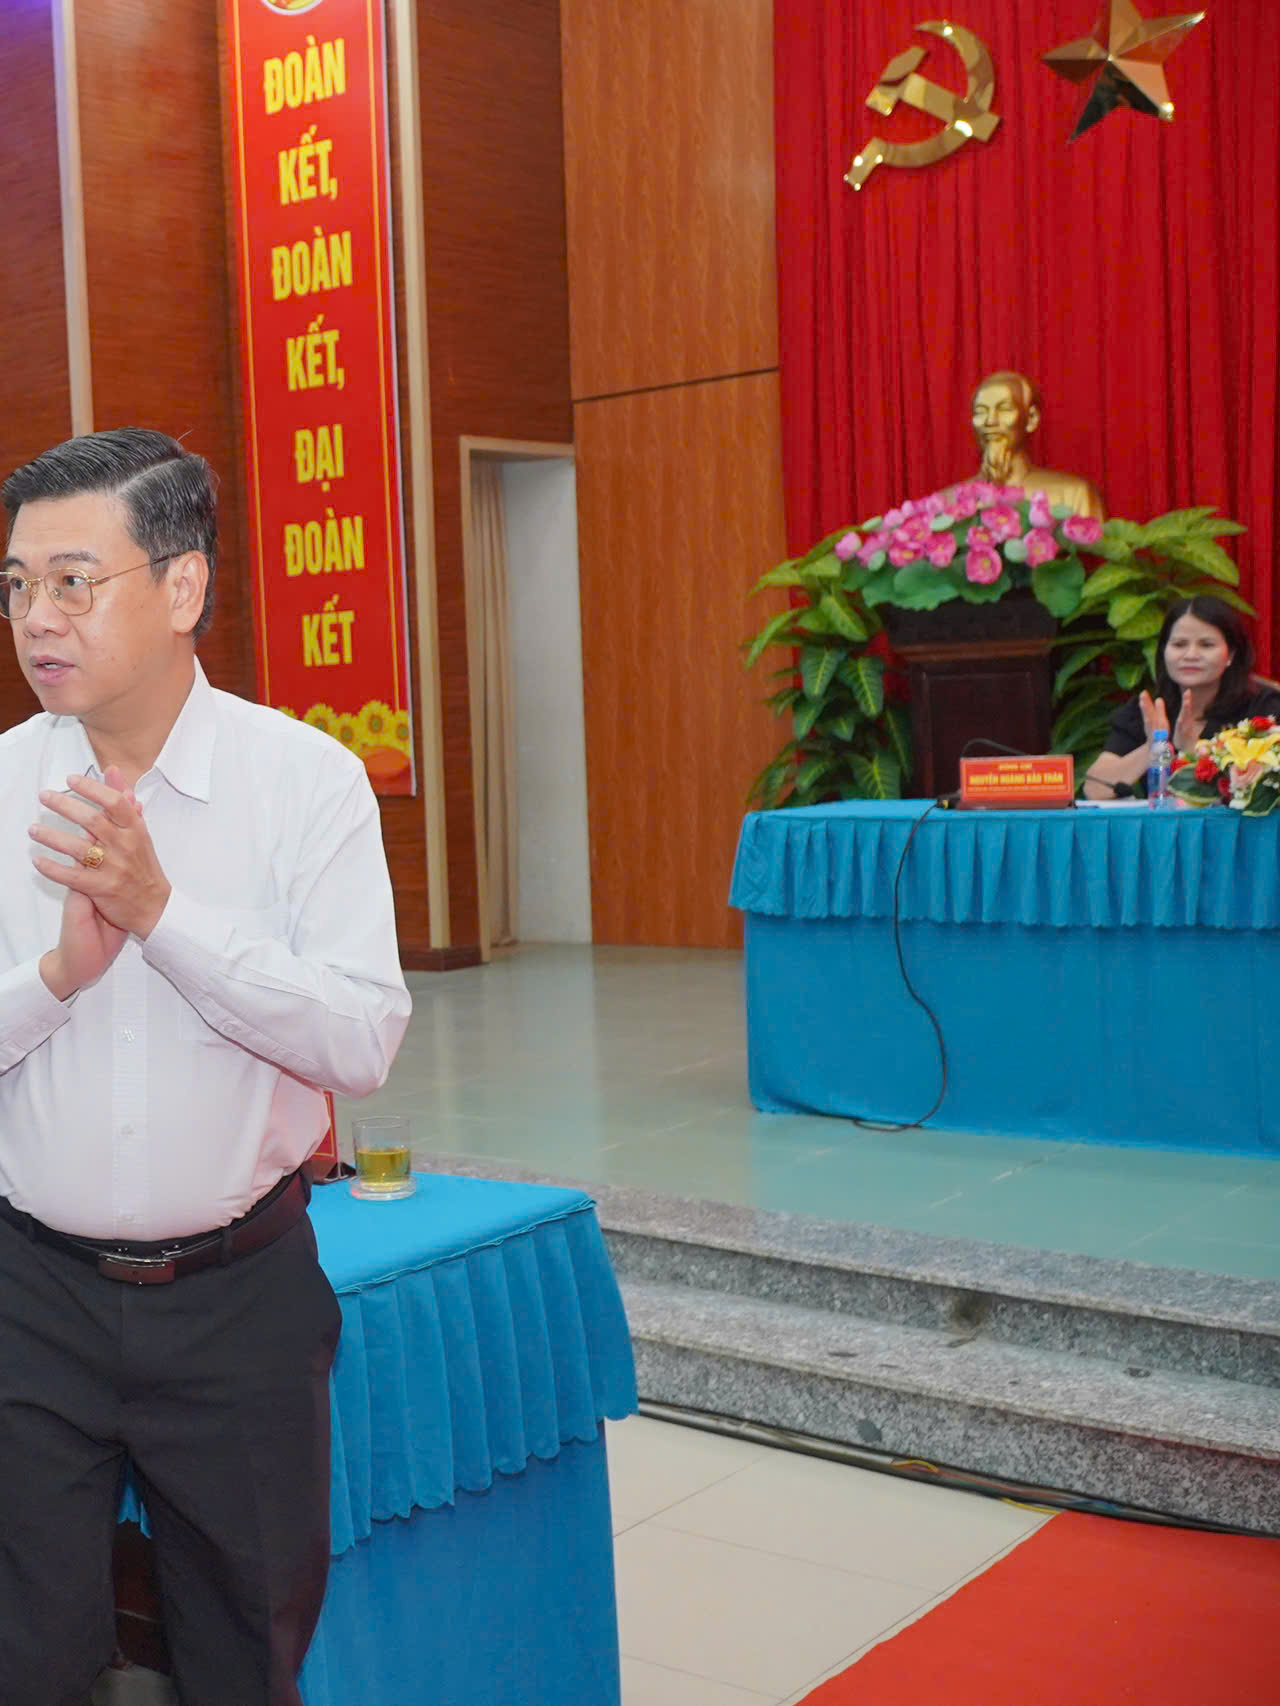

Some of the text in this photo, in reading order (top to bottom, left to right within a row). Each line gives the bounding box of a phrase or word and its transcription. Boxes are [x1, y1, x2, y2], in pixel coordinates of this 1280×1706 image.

[263, 34, 347, 115] ĐOÀN
[277, 124, 339, 206] KẾT,
[270, 225, 353, 301] ĐOÀN
[285, 314, 346, 392] KẾT,
[295, 423, 345, 492] ĐẠI
[283, 507, 366, 577] ĐOÀN
[301, 594, 356, 668] KẾT
